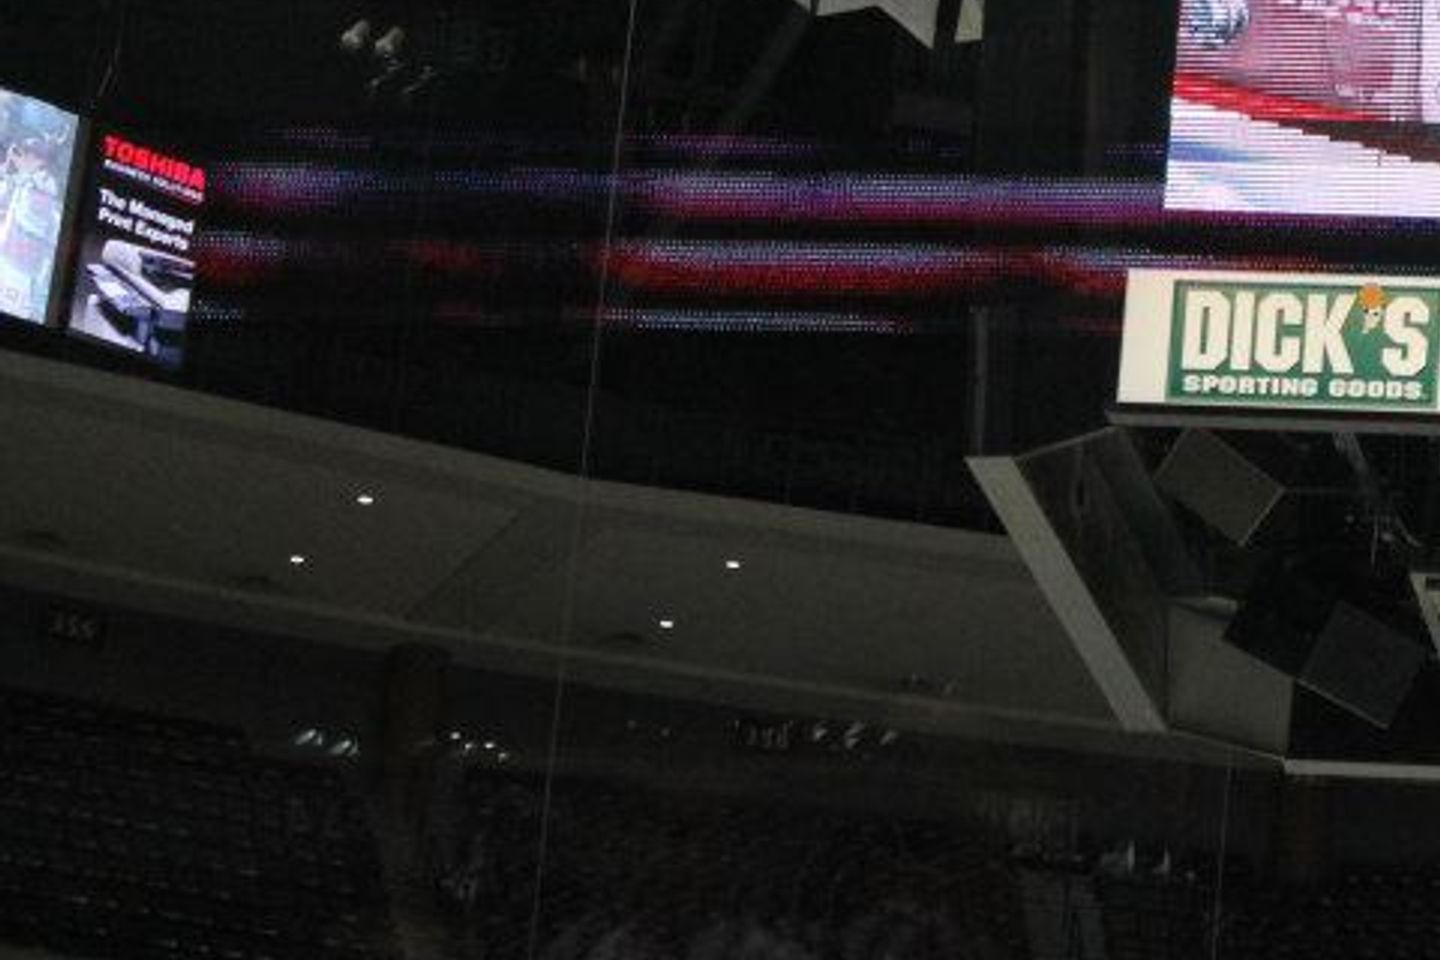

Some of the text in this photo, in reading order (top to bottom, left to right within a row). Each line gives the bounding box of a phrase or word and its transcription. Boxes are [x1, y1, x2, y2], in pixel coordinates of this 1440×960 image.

[104, 134, 205, 191] TOSHIBA
[100, 189, 126, 210] The
[99, 207, 132, 231] Print
[1181, 288, 1429, 377] DICK'S
[1183, 373, 1424, 401] SPORTING GOODS
